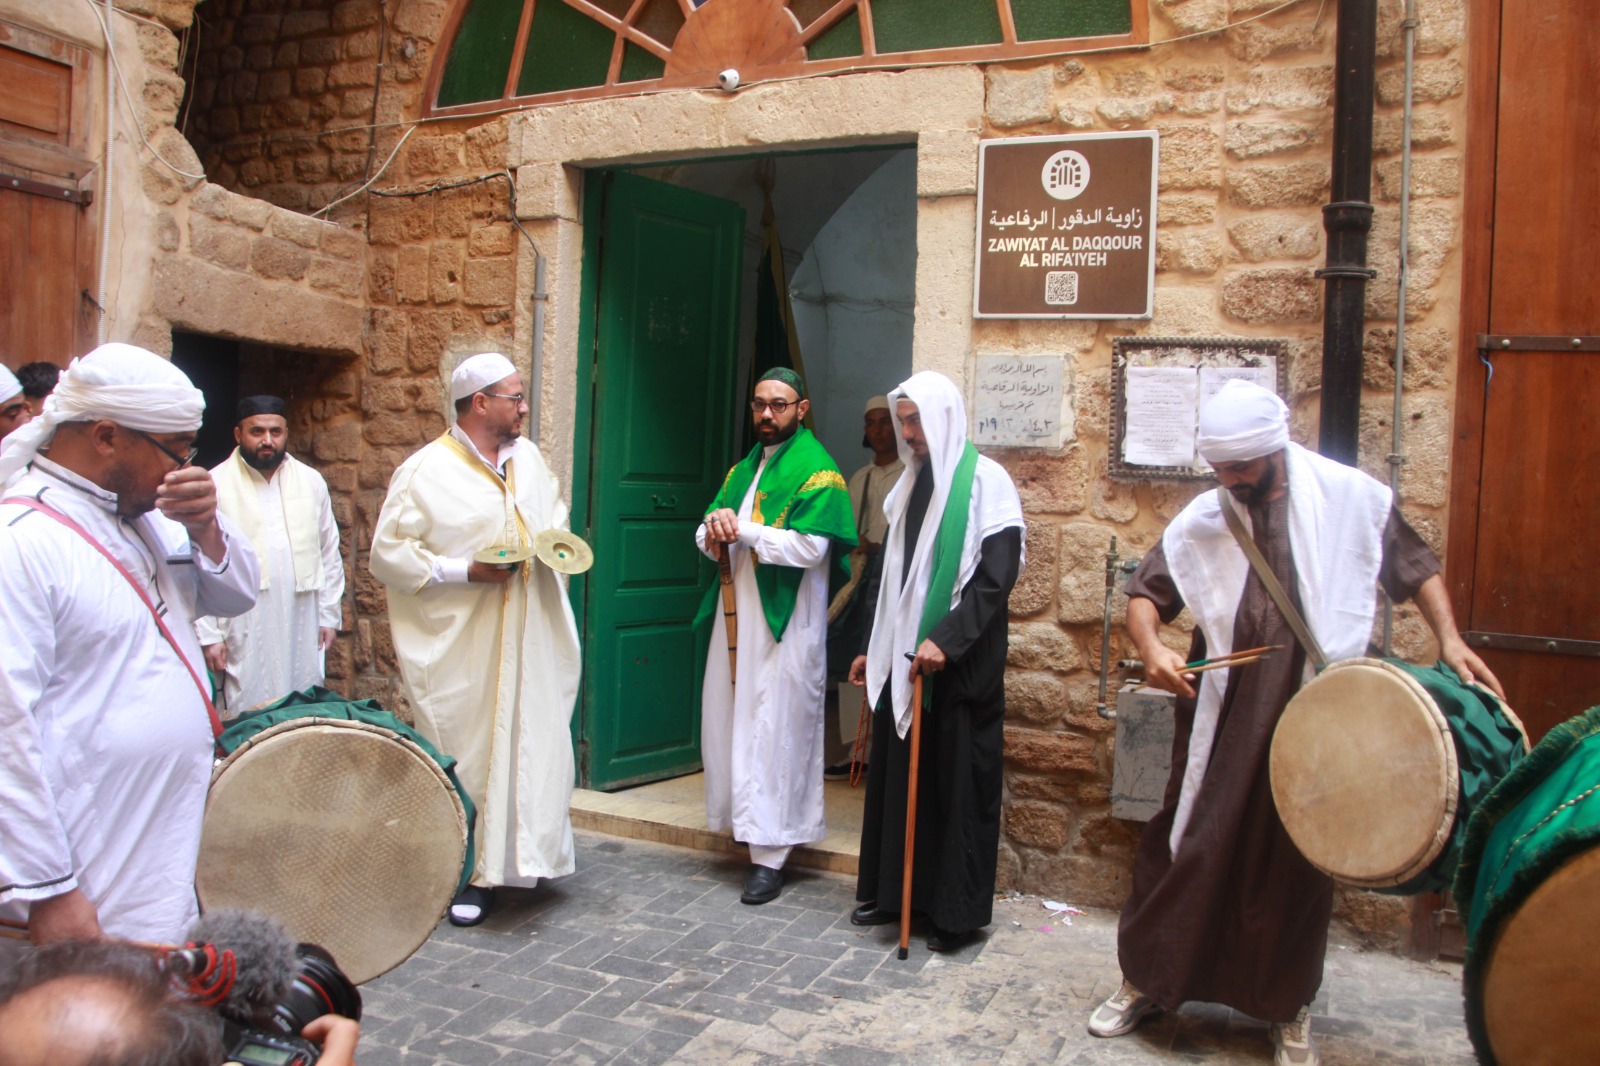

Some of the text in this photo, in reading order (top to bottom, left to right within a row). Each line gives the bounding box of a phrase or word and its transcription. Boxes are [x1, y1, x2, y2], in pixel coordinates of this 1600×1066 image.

[989, 209, 1048, 231] الرفاعية
[1058, 208, 1102, 229] الدقور
[1105, 206, 1143, 228] زاوية
[988, 235, 1142, 252] ZAWIYAT AL DAQQOUR
[1020, 252, 1107, 267] AL RIFA'IYEH
[1022, 363, 1035, 374] الله
[1020, 380, 1054, 396] الزاوية
